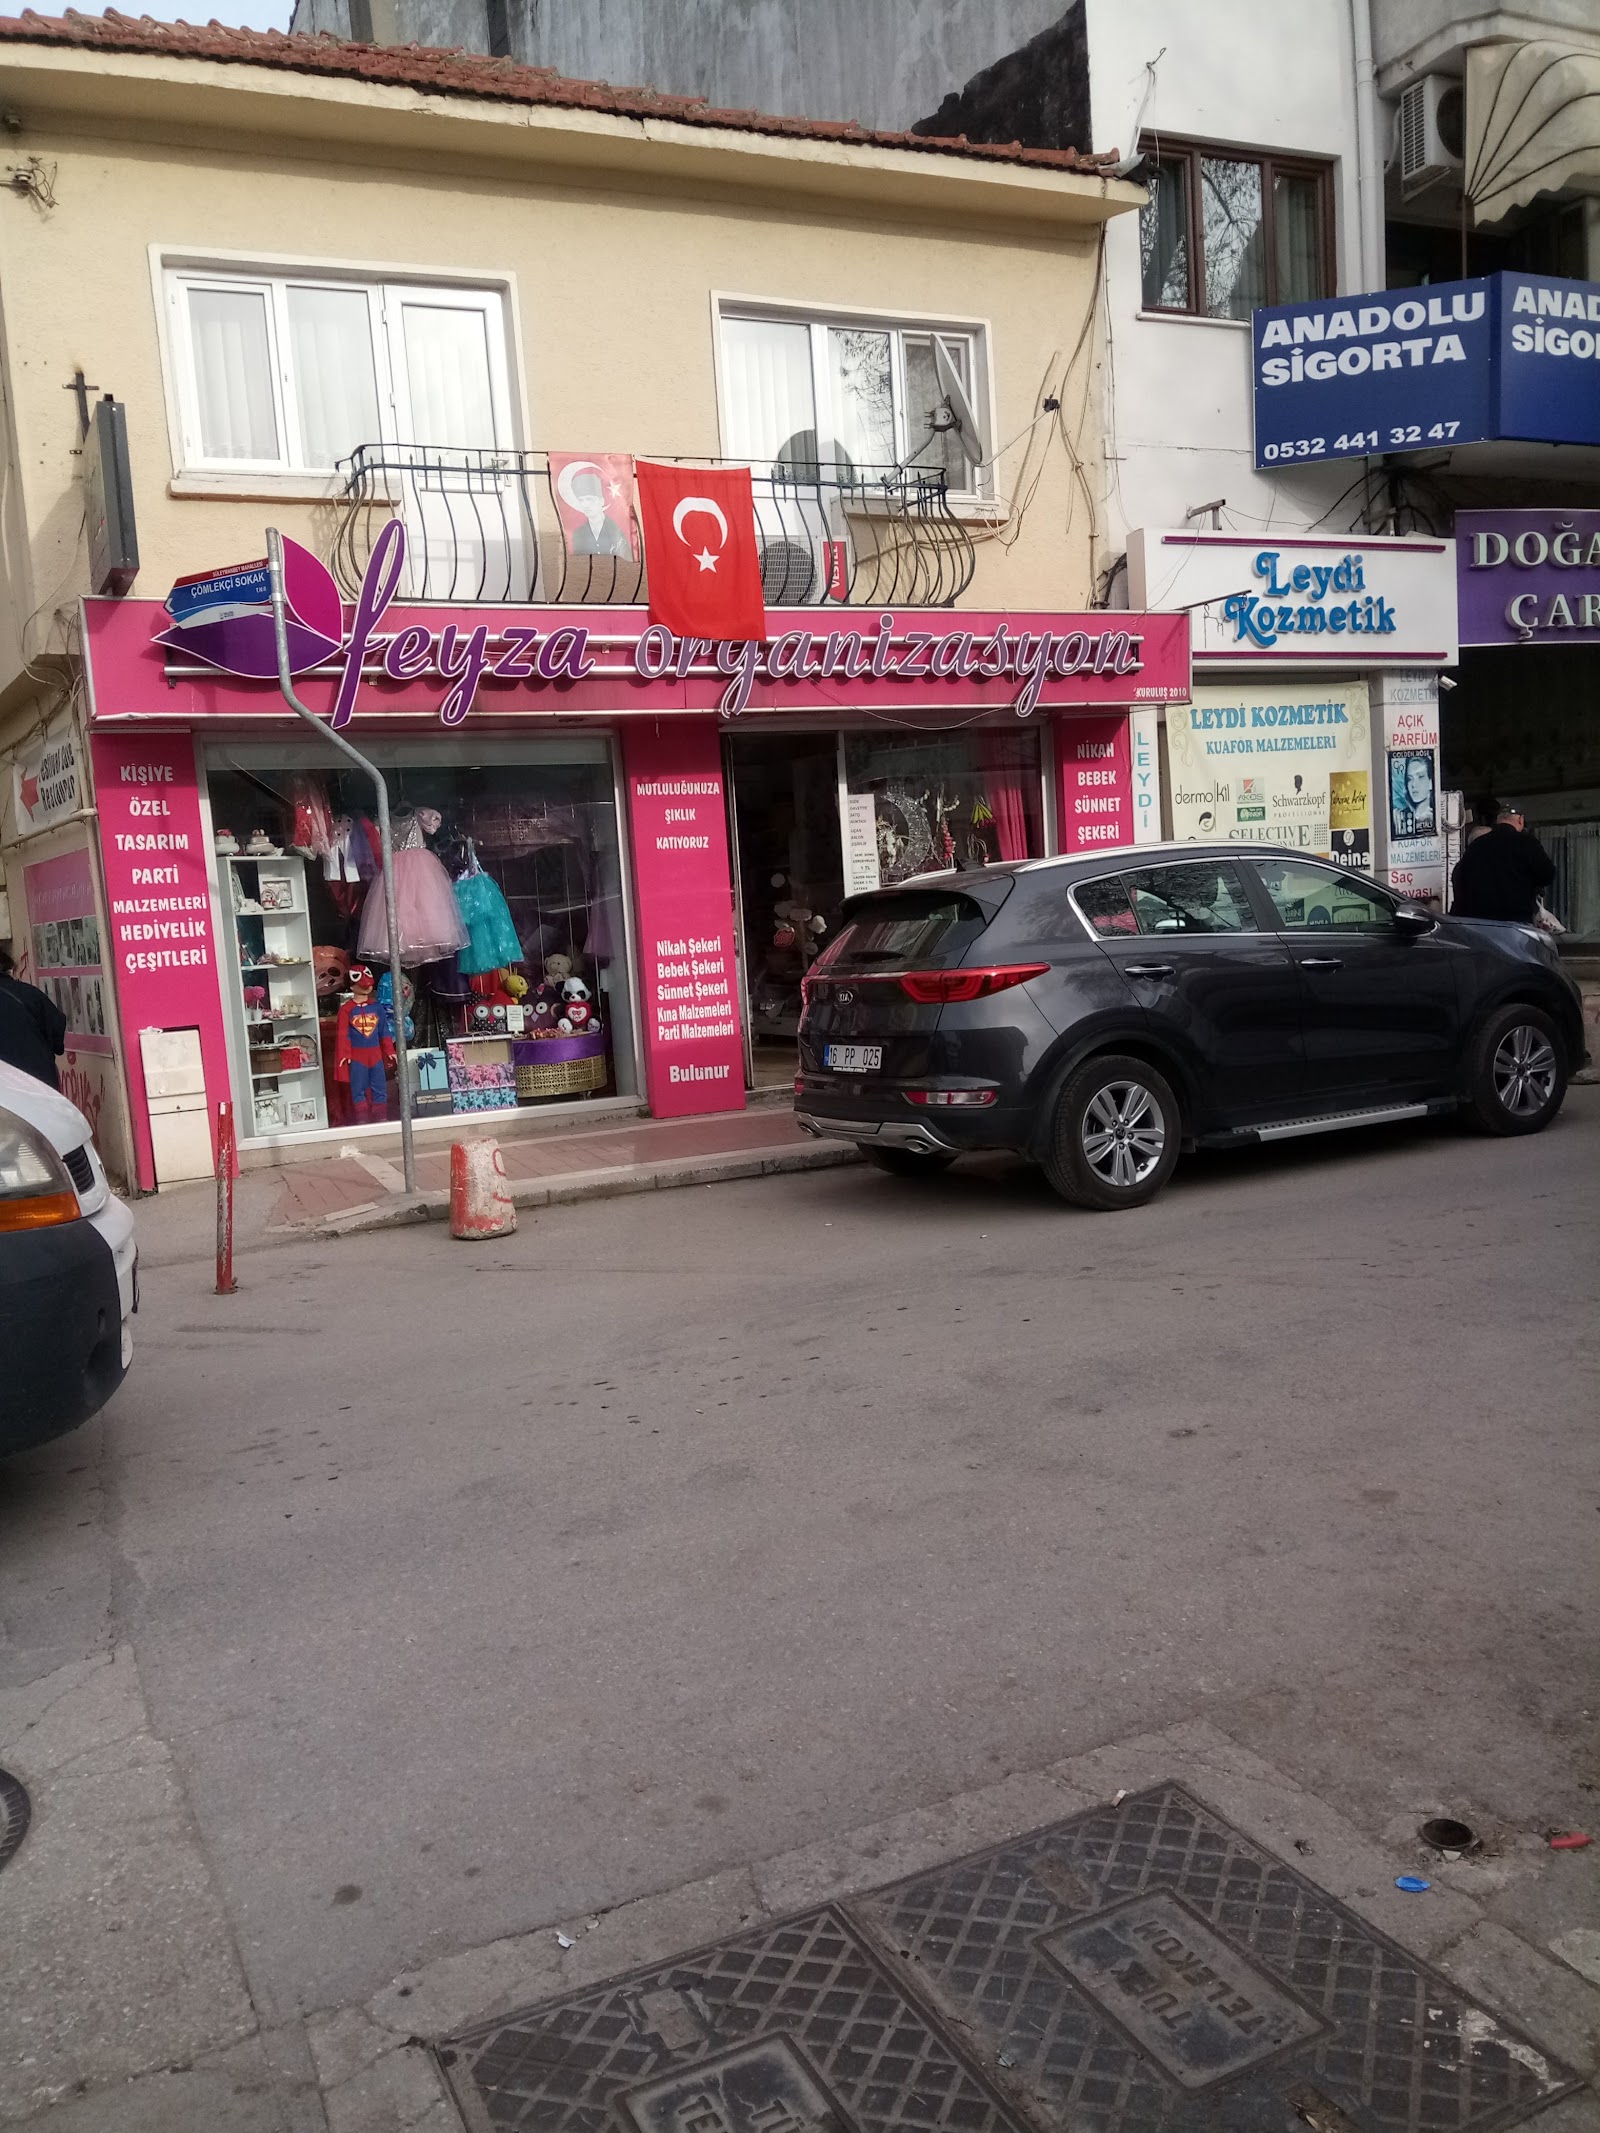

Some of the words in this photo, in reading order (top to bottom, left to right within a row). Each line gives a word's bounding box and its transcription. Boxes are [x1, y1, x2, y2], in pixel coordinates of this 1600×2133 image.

[1261, 292, 1485, 348] ANADOLU
[1511, 317, 1600, 360] SİGO
[1262, 333, 1466, 386] SİGORTA
[1264, 438, 1327, 461] 0532
[1333, 430, 1379, 452] 441
[1390, 425, 1422, 445] 32
[1428, 420, 1461, 440] 47
[190, 576, 234, 599] ÇÖMLEKÇİ
[235, 572, 266, 588] SOKAK
[1253, 551, 1367, 601] Leydi
[331, 518, 596, 729] feyza
[635, 612, 1137, 719] organizasyon
[1224, 594, 1398, 647] Kozmetik
[1169, 687, 1187, 698] 2010
[1190, 703, 1247, 730] LEYDİ
[1251, 699, 1349, 728] KOZMETİK
[1397, 715, 1424, 730] AÇIK
[1256, 733, 1337, 753] MALZEMELERİ
[1392, 730, 1438, 746] PARFÜM
[1077, 740, 1114, 759] NİKAH
[120, 763, 174, 786] KİŞİYE
[1078, 770, 1116, 786] BEBEK
[1137, 732, 1152, 828] LEYDİ
[637, 780, 720, 796] MUTLULUĞUNUZA
[129, 796, 171, 816] ÖZEL
[1074, 795, 1121, 814] SÜNNET
[1272, 792, 1327, 808] Schwarzkopf
[664, 808, 696, 825] ŞIKLIK
[1274, 810, 1326, 818] PROFESSIONAL
[115, 833, 189, 851] TASARIM
[656, 835, 709, 850] KATIYORUZ
[1078, 821, 1120, 845] ŞEKERİ
[1229, 824, 1311, 847] SELECTIVE
[132, 864, 179, 884] PARTİ
[1391, 871, 1414, 885] Saç
[113, 893, 207, 914] MALZEMELERİ
[120, 917, 206, 941] HEDİYELİK
[657, 939, 687, 957] Nikah
[688, 935, 722, 958] Şekeri
[657, 961, 691, 979] Bebek
[691, 957, 725, 980] Şekeri
[657, 983, 695, 1001] Sünnet
[695, 979, 729, 1002] Şekeri
[657, 1007, 678, 1023] Kına
[679, 1000, 732, 1021] Malzemeleri
[658, 1024, 680, 1041] Parti
[681, 1020, 735, 1039] Malzemeleri
[829, 1047, 838, 1064] 16
[844, 1047, 856, 1065] PP
[862, 1048, 881, 1067] 025
[669, 1064, 730, 1083] Bulunur
[1133, 1919, 1267, 2035] TELEKOM
